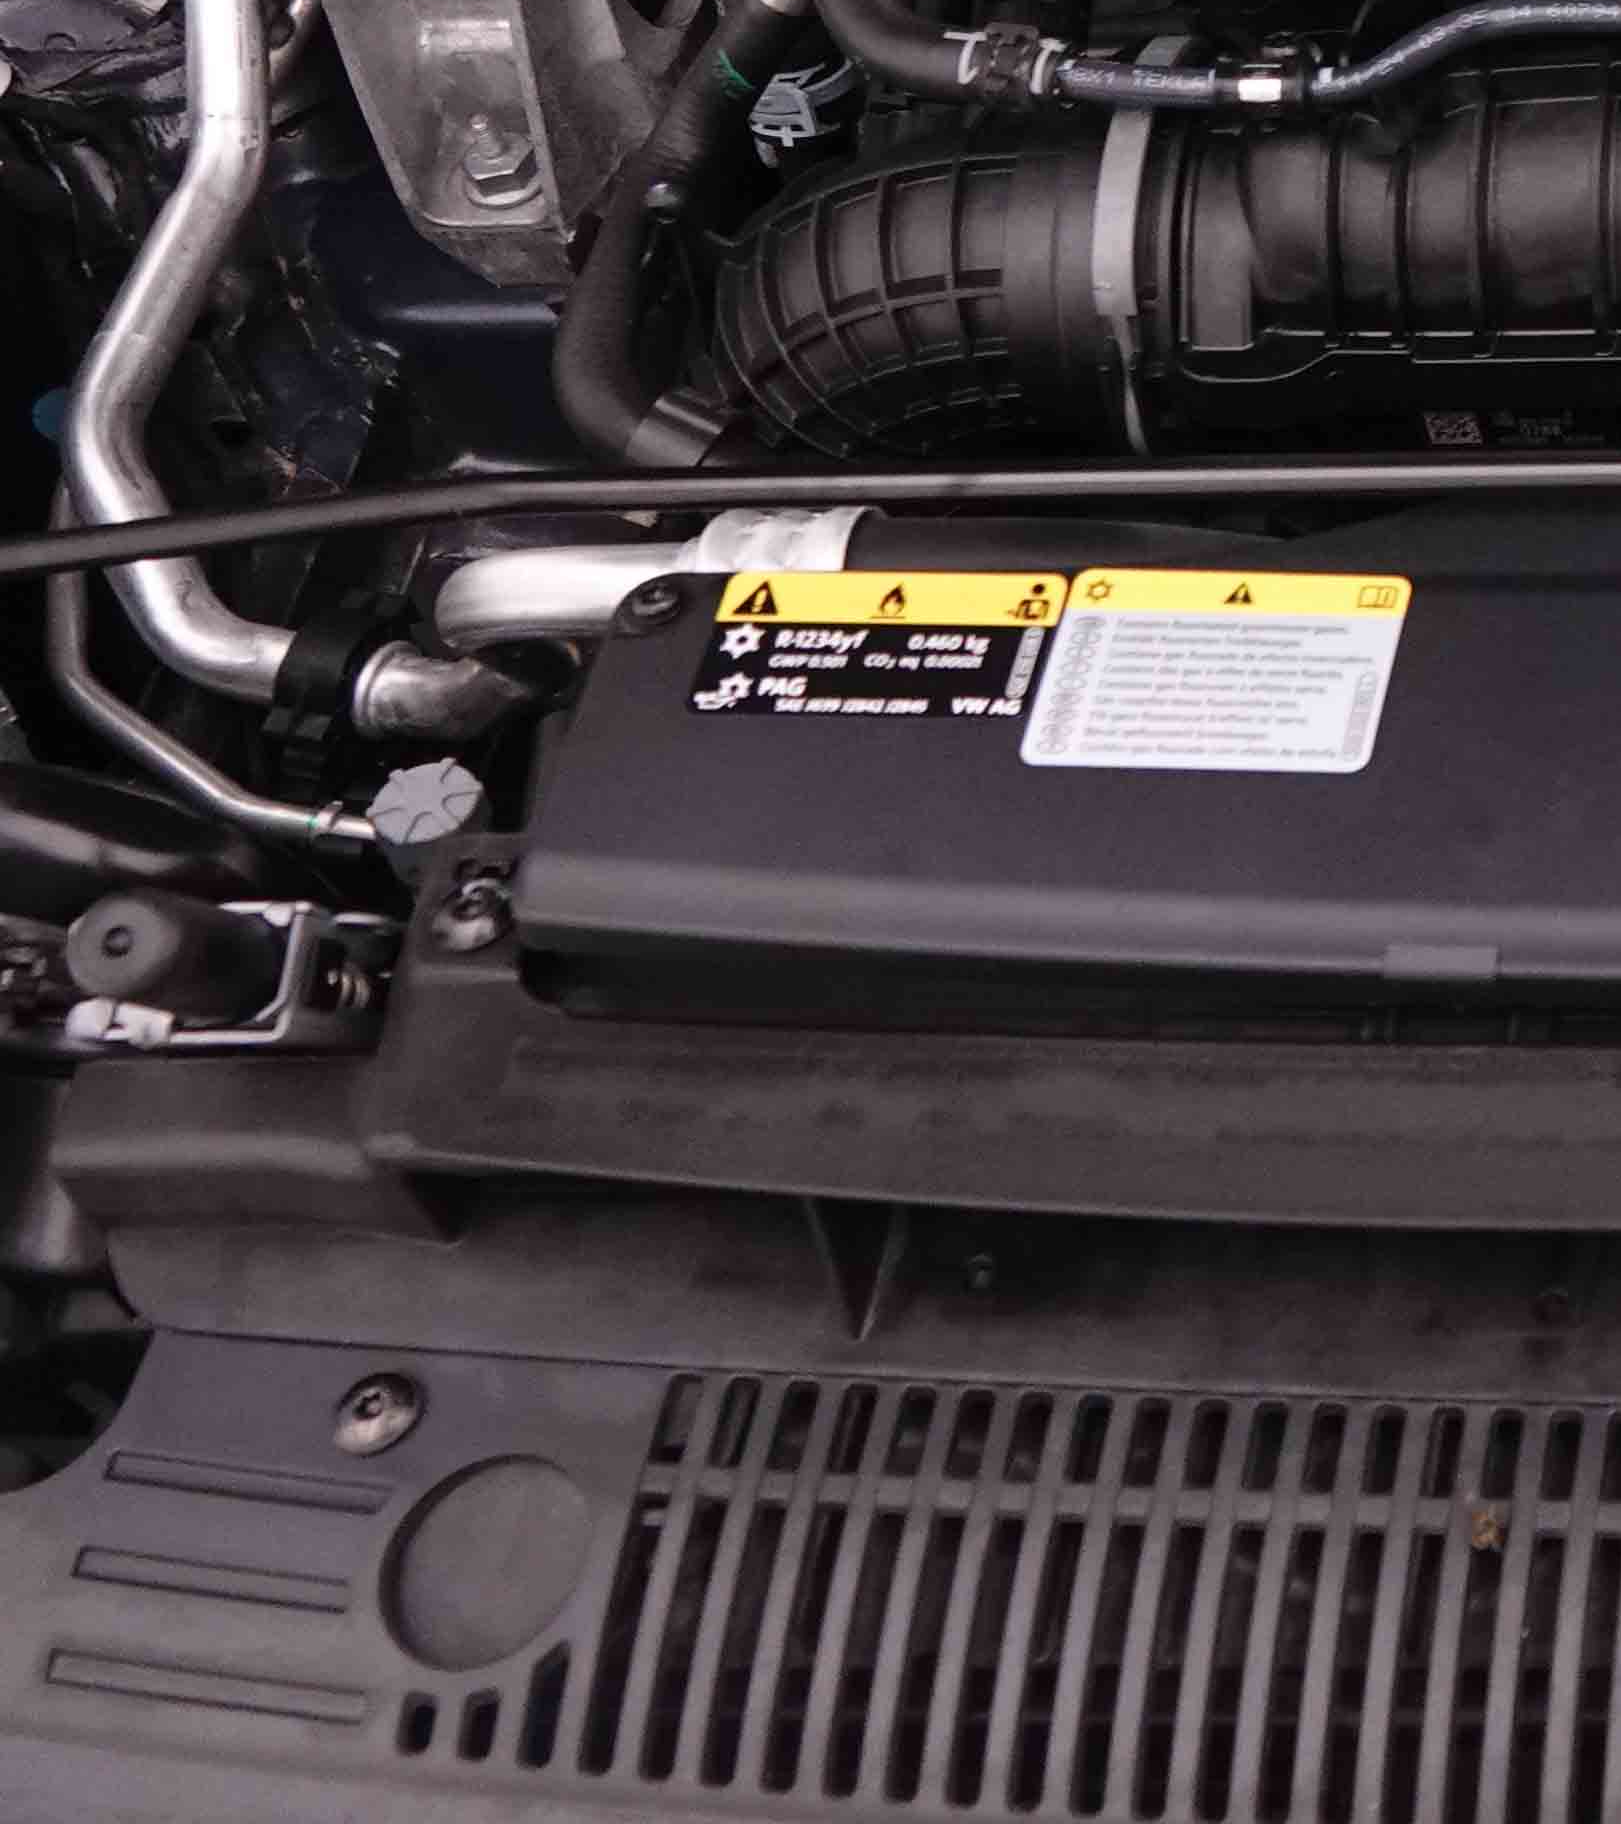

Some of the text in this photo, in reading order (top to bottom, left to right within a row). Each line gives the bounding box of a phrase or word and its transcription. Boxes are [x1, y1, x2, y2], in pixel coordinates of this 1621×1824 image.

[757, 677, 807, 697] PAG
[951, 698, 990, 715] VW
[988, 699, 1022, 716] AG
